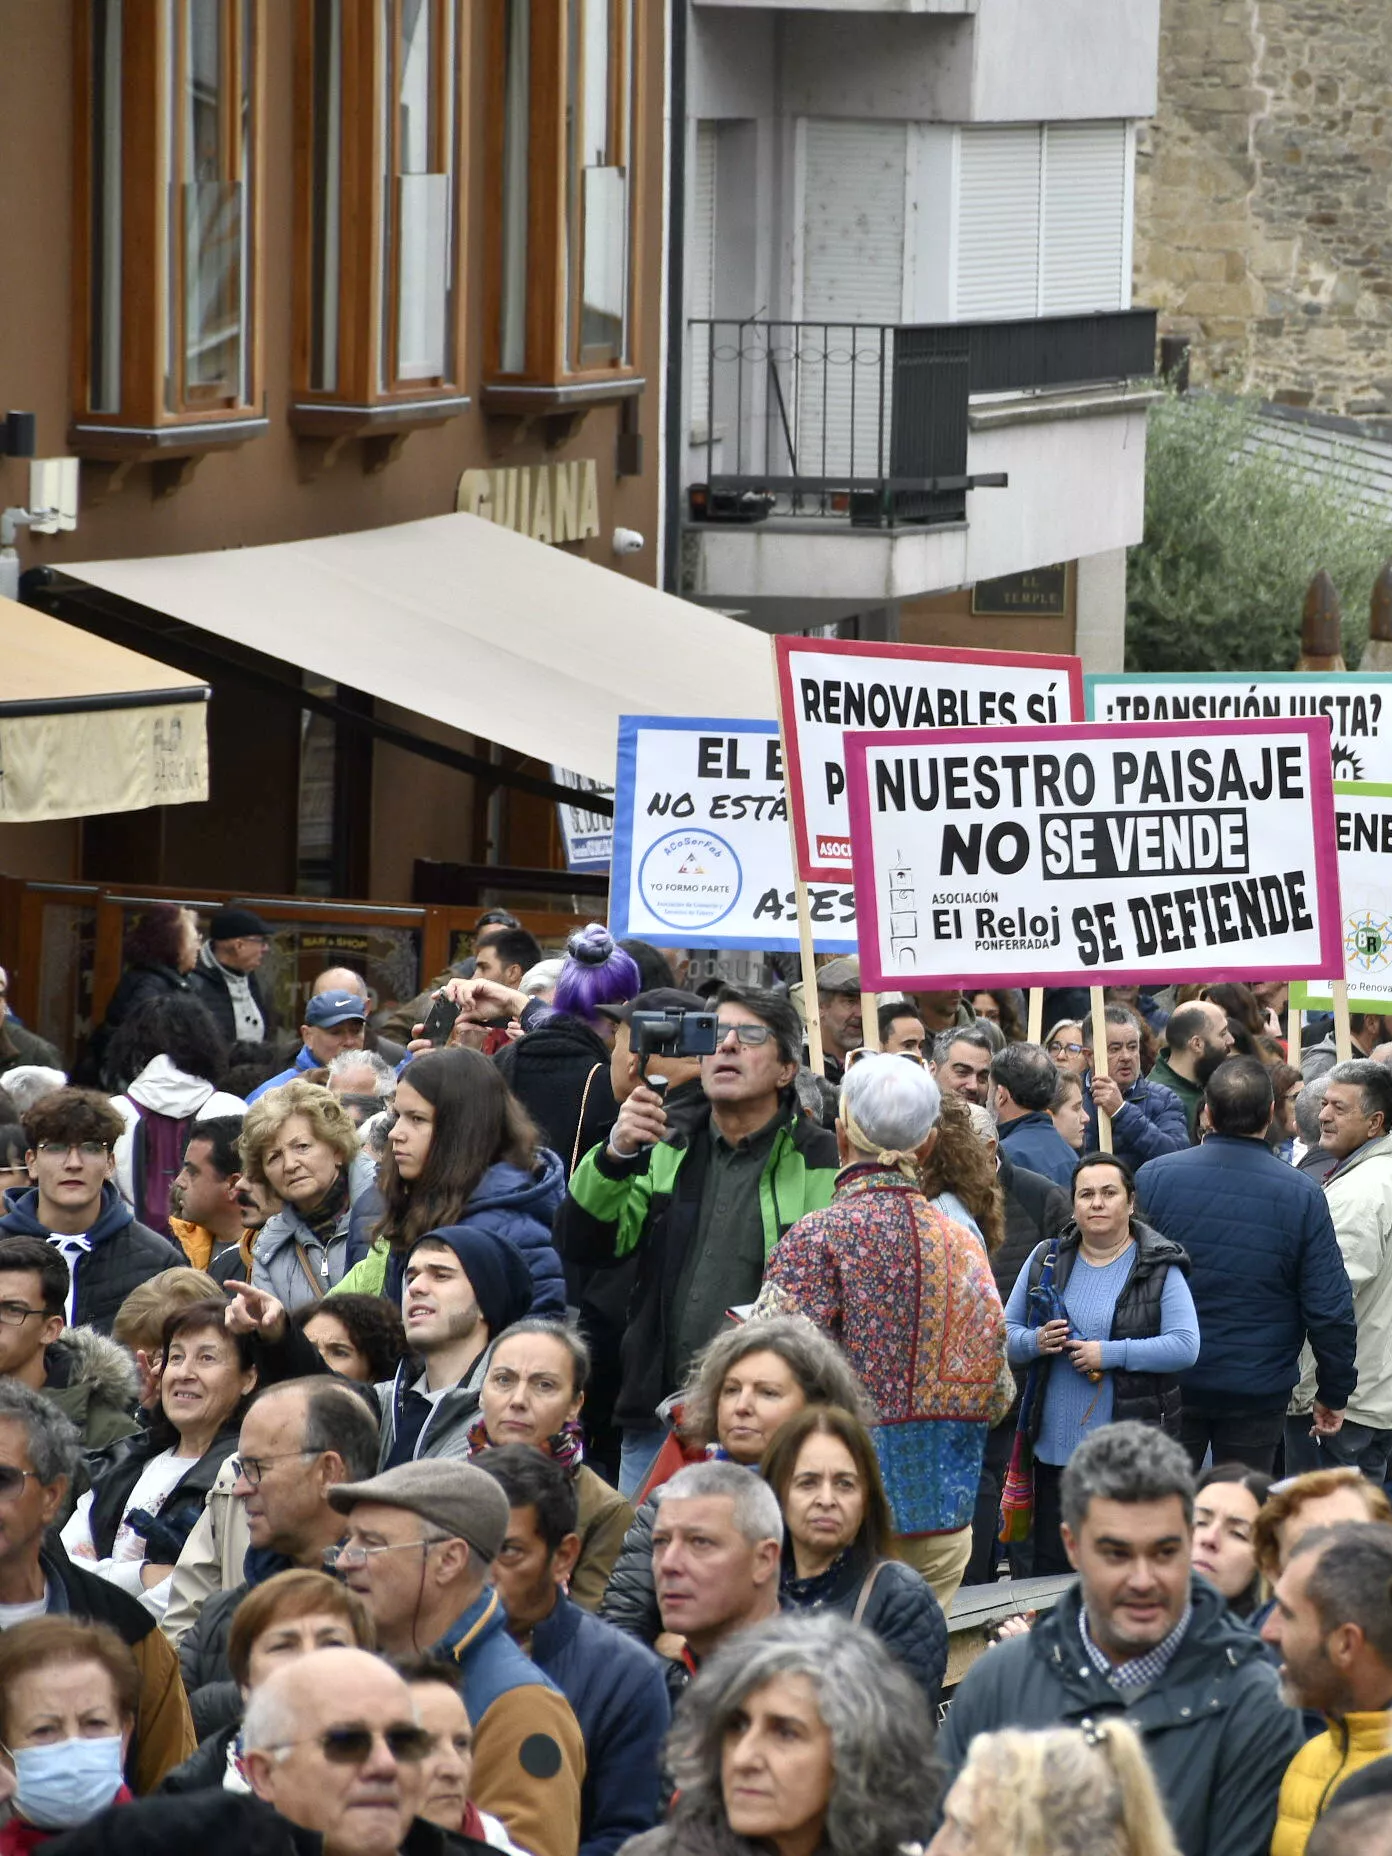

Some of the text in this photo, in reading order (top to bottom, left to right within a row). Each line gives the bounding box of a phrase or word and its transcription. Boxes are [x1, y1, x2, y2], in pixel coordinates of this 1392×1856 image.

[801, 678, 1057, 728] RENOVABLES SÍ
[697, 737, 750, 780] EL
[875, 752, 1096, 812] NUESTRO
[1112, 746, 1304, 805] PAISAJE
[647, 789, 788, 821] NO ESTÁ
[939, 812, 1246, 876] NO SE VENDE
[651, 883, 729, 893] YO FORMO PARTE
[932, 889, 999, 905] ASOCIACIÓN
[932, 905, 1061, 947] El Reloj
[1072, 870, 1314, 966] SE DEFIENDE
[975, 938, 1050, 951] PONFERRADA
